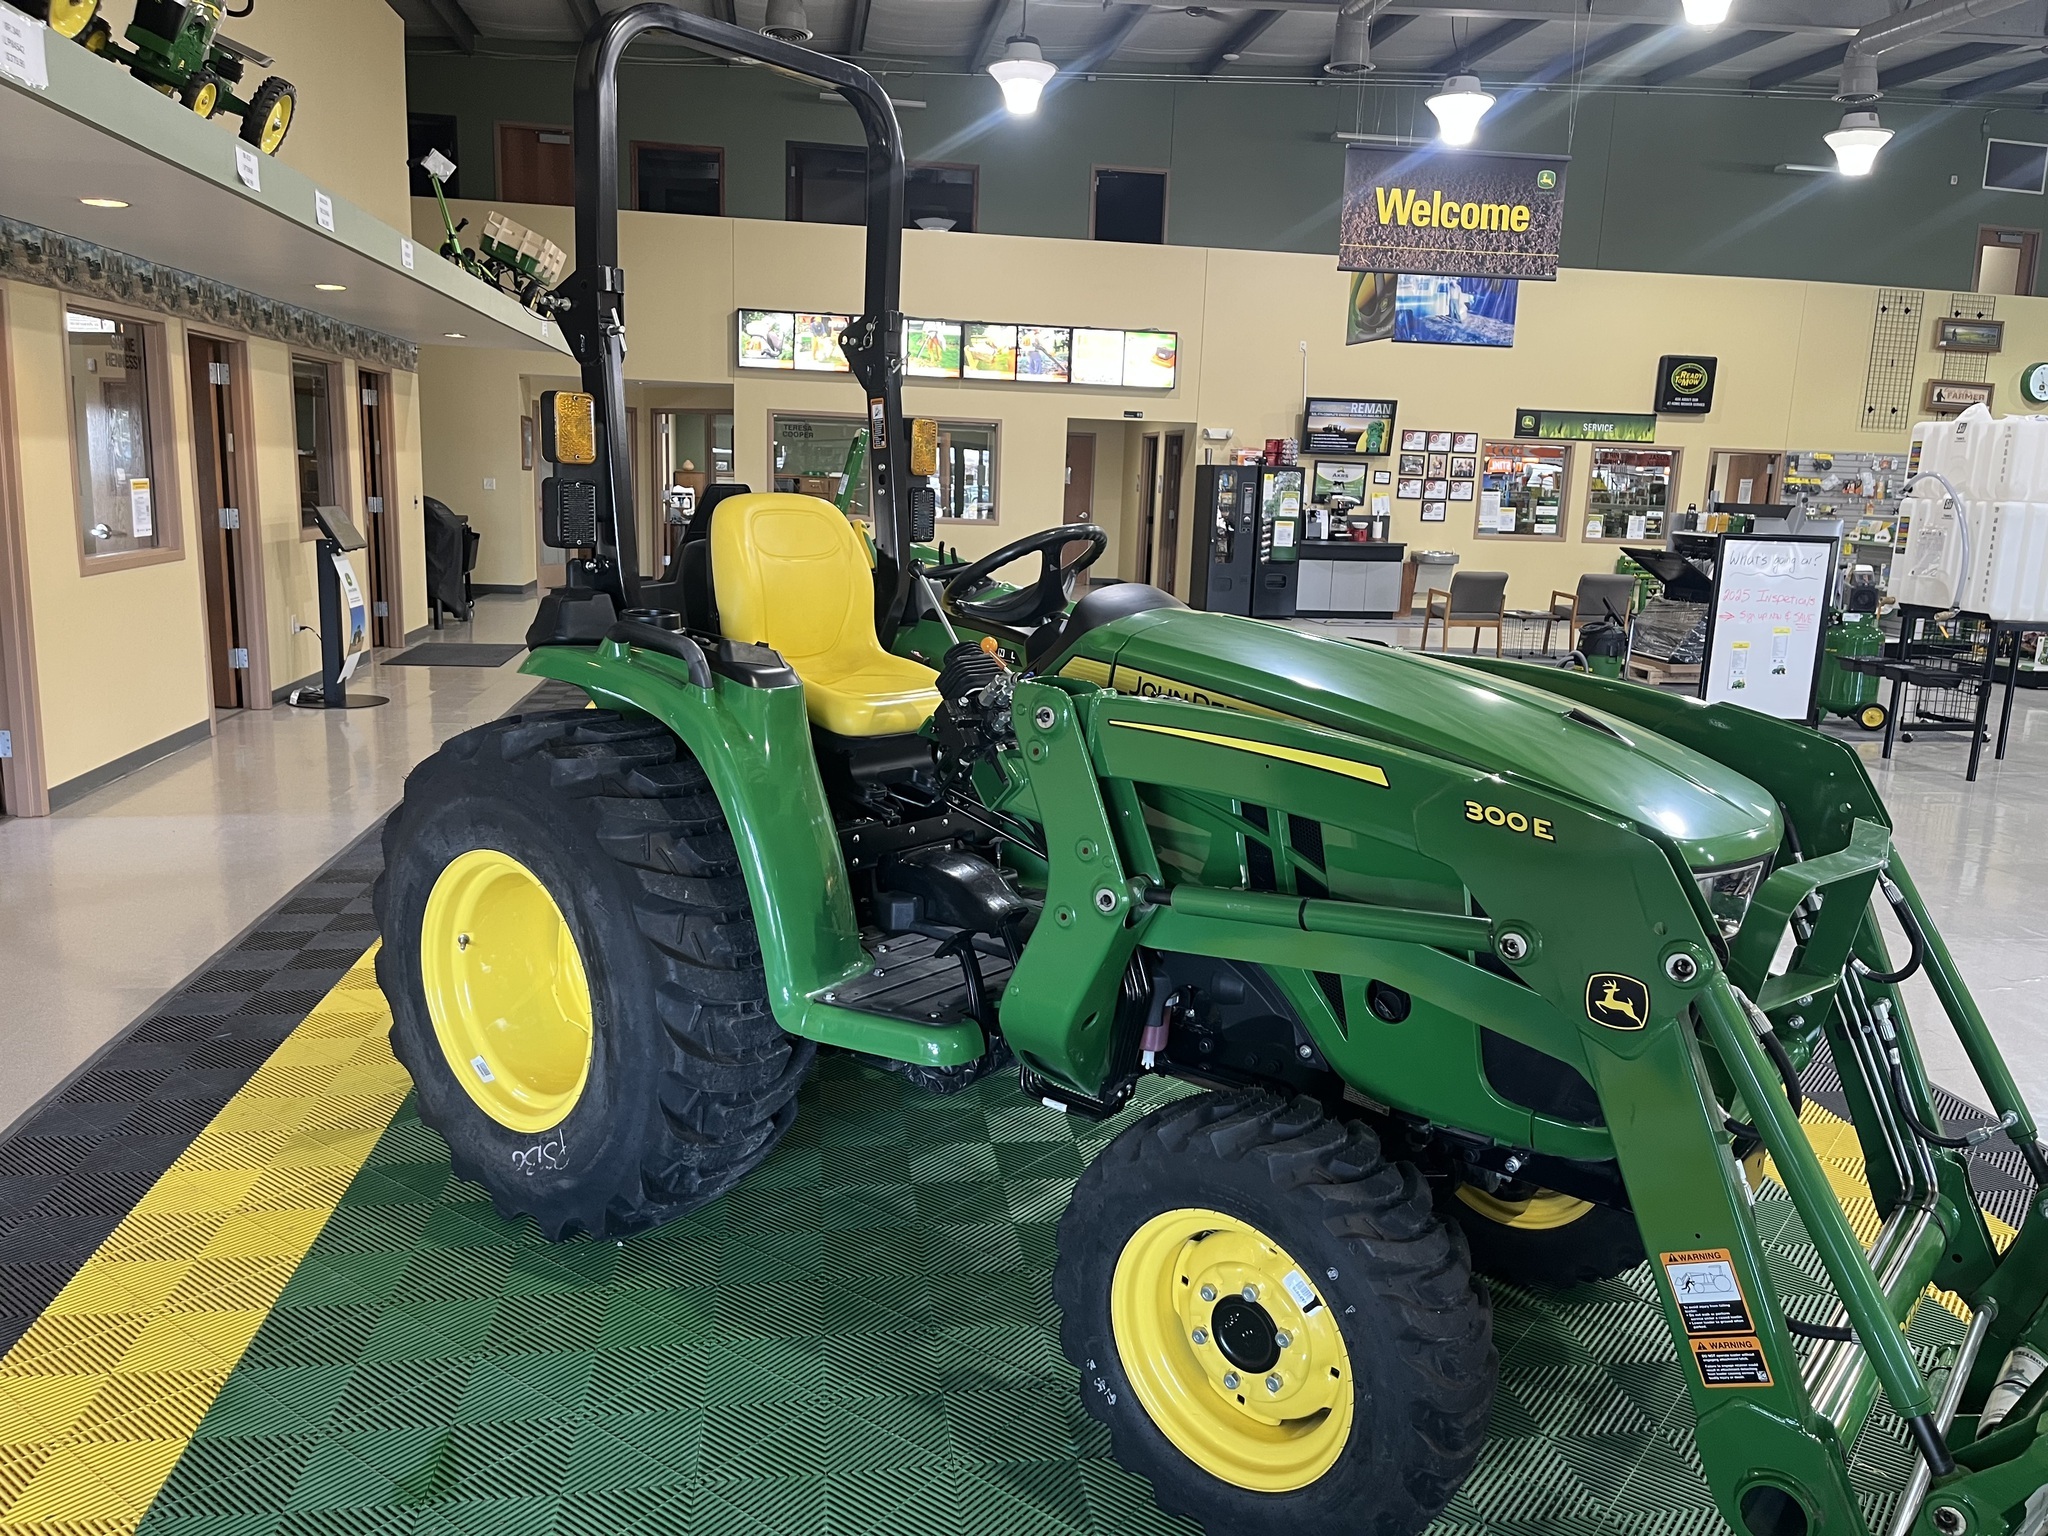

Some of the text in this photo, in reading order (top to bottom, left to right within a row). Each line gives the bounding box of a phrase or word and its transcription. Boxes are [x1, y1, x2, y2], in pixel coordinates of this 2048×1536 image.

[1375, 186, 1531, 232] Welcome
[1681, 371, 1702, 380] READY
[1947, 392, 1985, 401] FARMER
[1351, 403, 1391, 414] REMAN
[1582, 423, 1614, 432] SERVICE
[1772, 556, 1797, 574] going
[1722, 589, 1750, 602] 2025
[1758, 613, 1767, 621] up
[1794, 611, 1815, 623] SAVE
[1010, 651, 1016, 660] L
[1677, 1252, 1722, 1262] WARNING
[1709, 1340, 1753, 1350] WARNING
